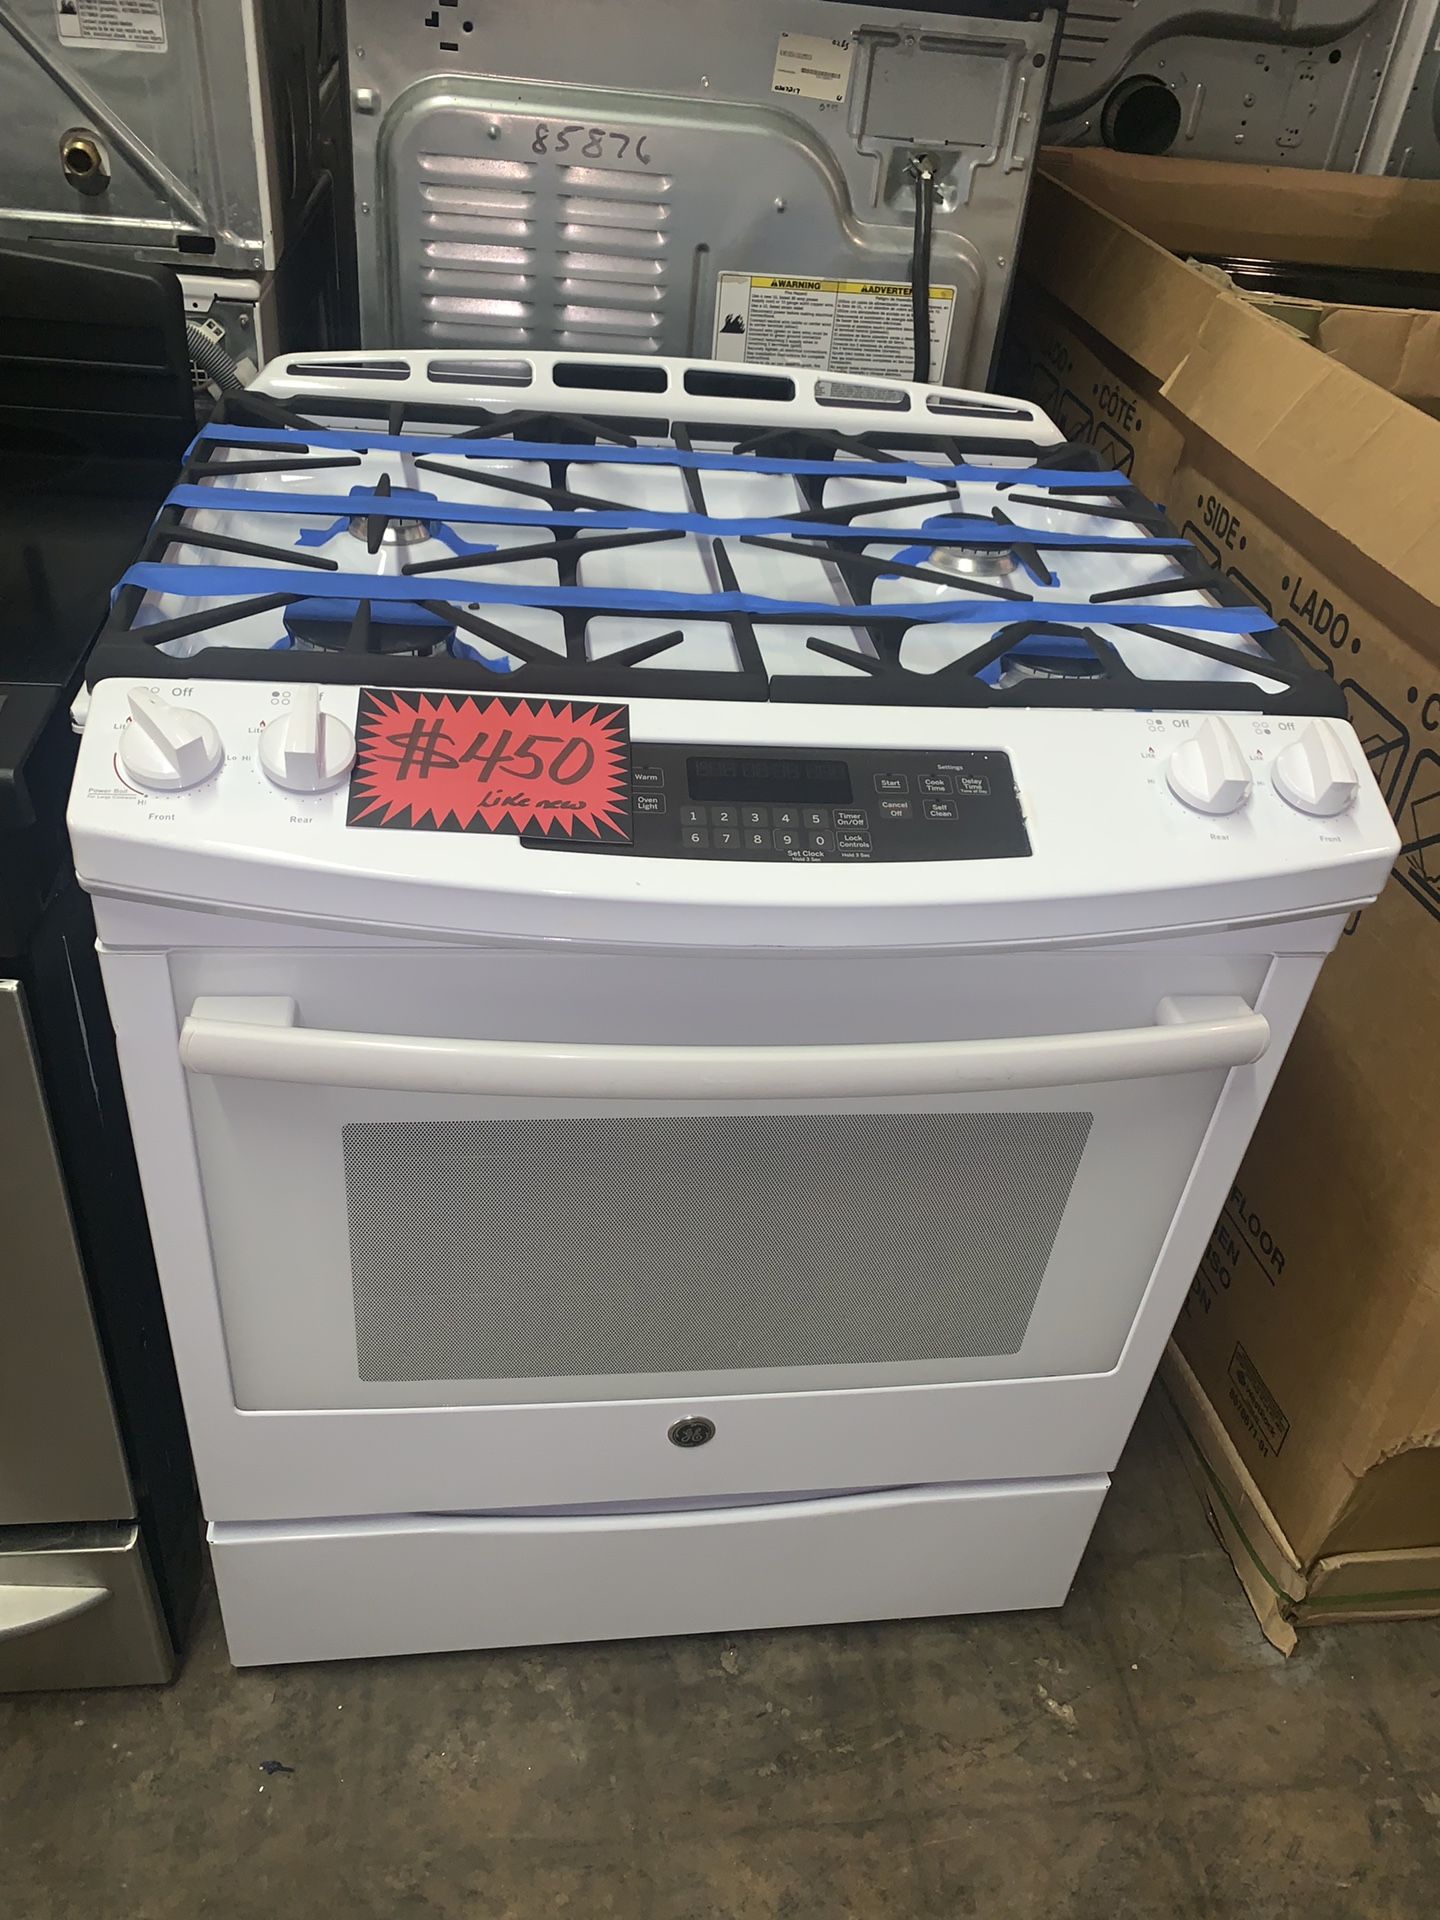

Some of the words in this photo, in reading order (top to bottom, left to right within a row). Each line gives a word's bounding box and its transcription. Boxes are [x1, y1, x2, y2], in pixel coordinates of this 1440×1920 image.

[532, 123, 651, 165] 85876
[777, 279, 821, 290] WARNING
[1098, 384, 1138, 432] CÔTÉ
[1203, 495, 1240, 551] SIDE
[1289, 577, 1349, 648] LADO
[172, 687, 195, 697] Off
[1172, 719, 1190, 729] Off
[1278, 722, 1295, 731] Off
[371, 718, 595, 786] $450
[634, 773, 658, 781] Warm
[882, 801, 908, 809] Cancel
[148, 812, 176, 821] Front
[289, 815, 313, 824] Rear
[690, 812, 697, 821] 1
[720, 813, 729, 822] 2
[751, 813, 759, 822] 3
[781, 814, 791, 823] 4
[812, 814, 820, 823] 5
[691, 833, 700, 842] 6
[722, 834, 730, 843] 7
[754, 835, 762, 844] 8
[783, 835, 792, 845] 9
[816, 836, 825, 845] 0
[1231, 1185, 1285, 1275] FLOOR
